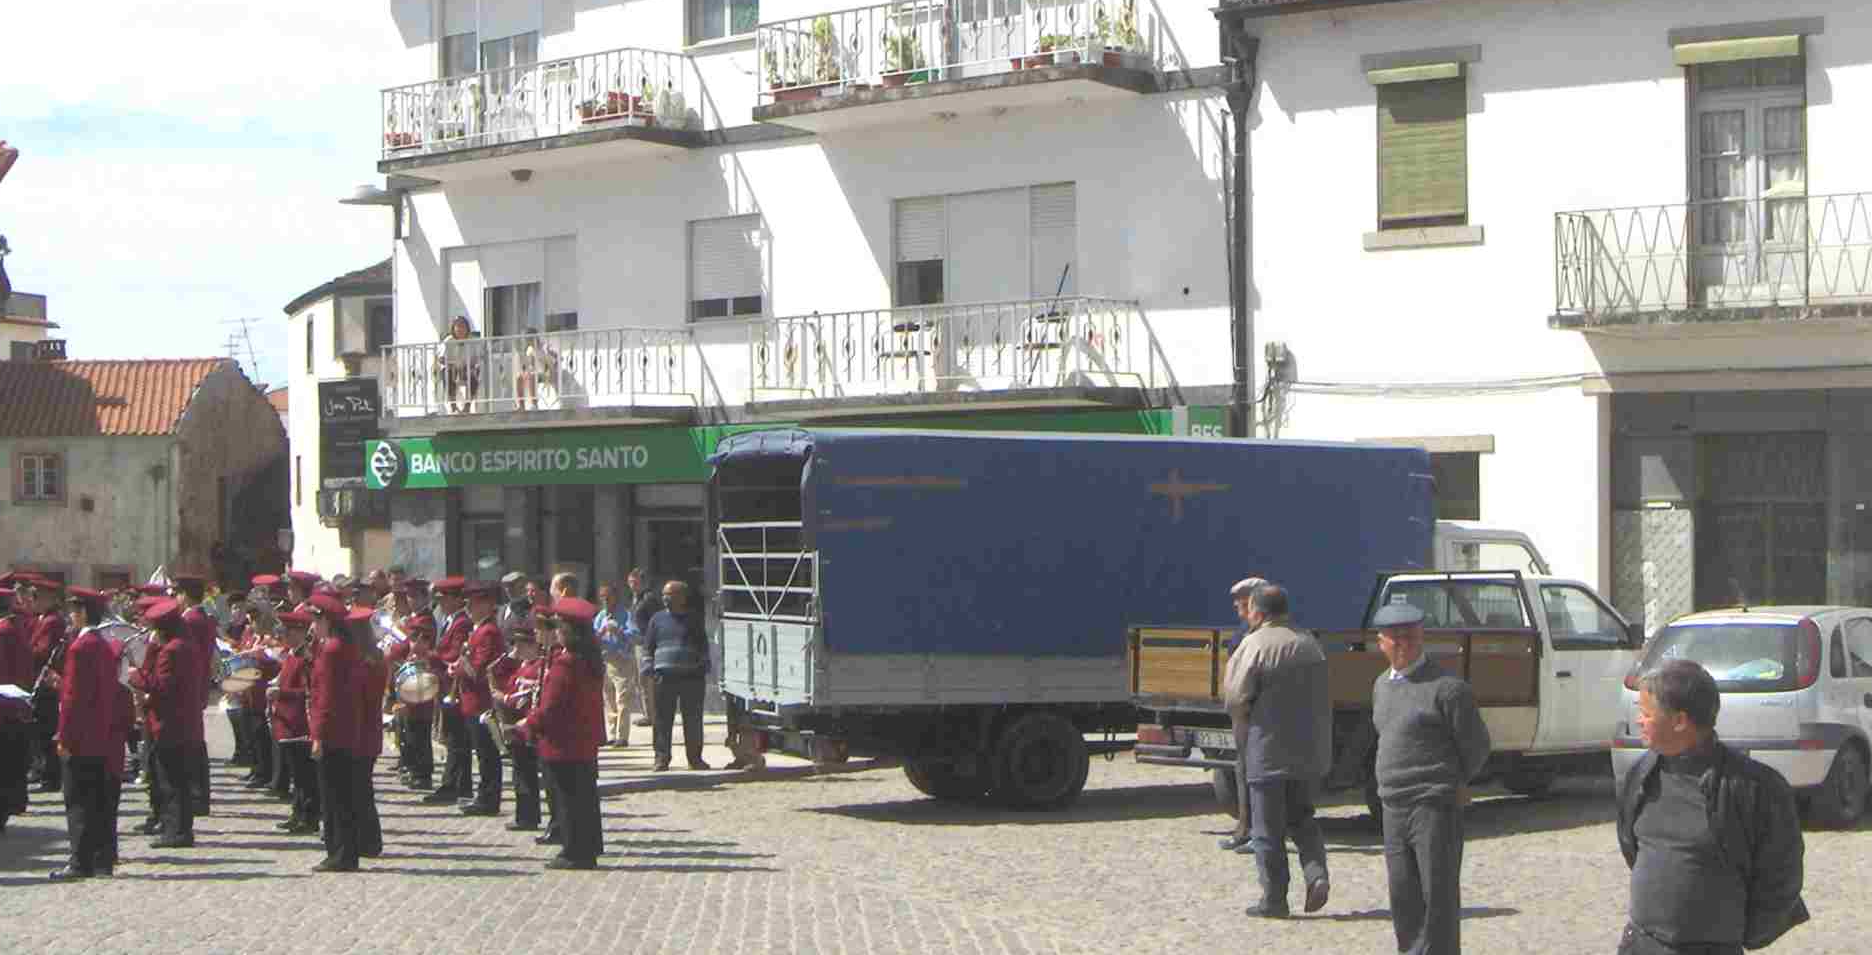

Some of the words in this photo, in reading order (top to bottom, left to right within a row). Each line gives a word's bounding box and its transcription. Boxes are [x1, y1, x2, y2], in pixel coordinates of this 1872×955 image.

[410, 451, 477, 475] BANCO
[481, 449, 571, 473] ESPIRITO
[575, 445, 650, 470] SANTO
